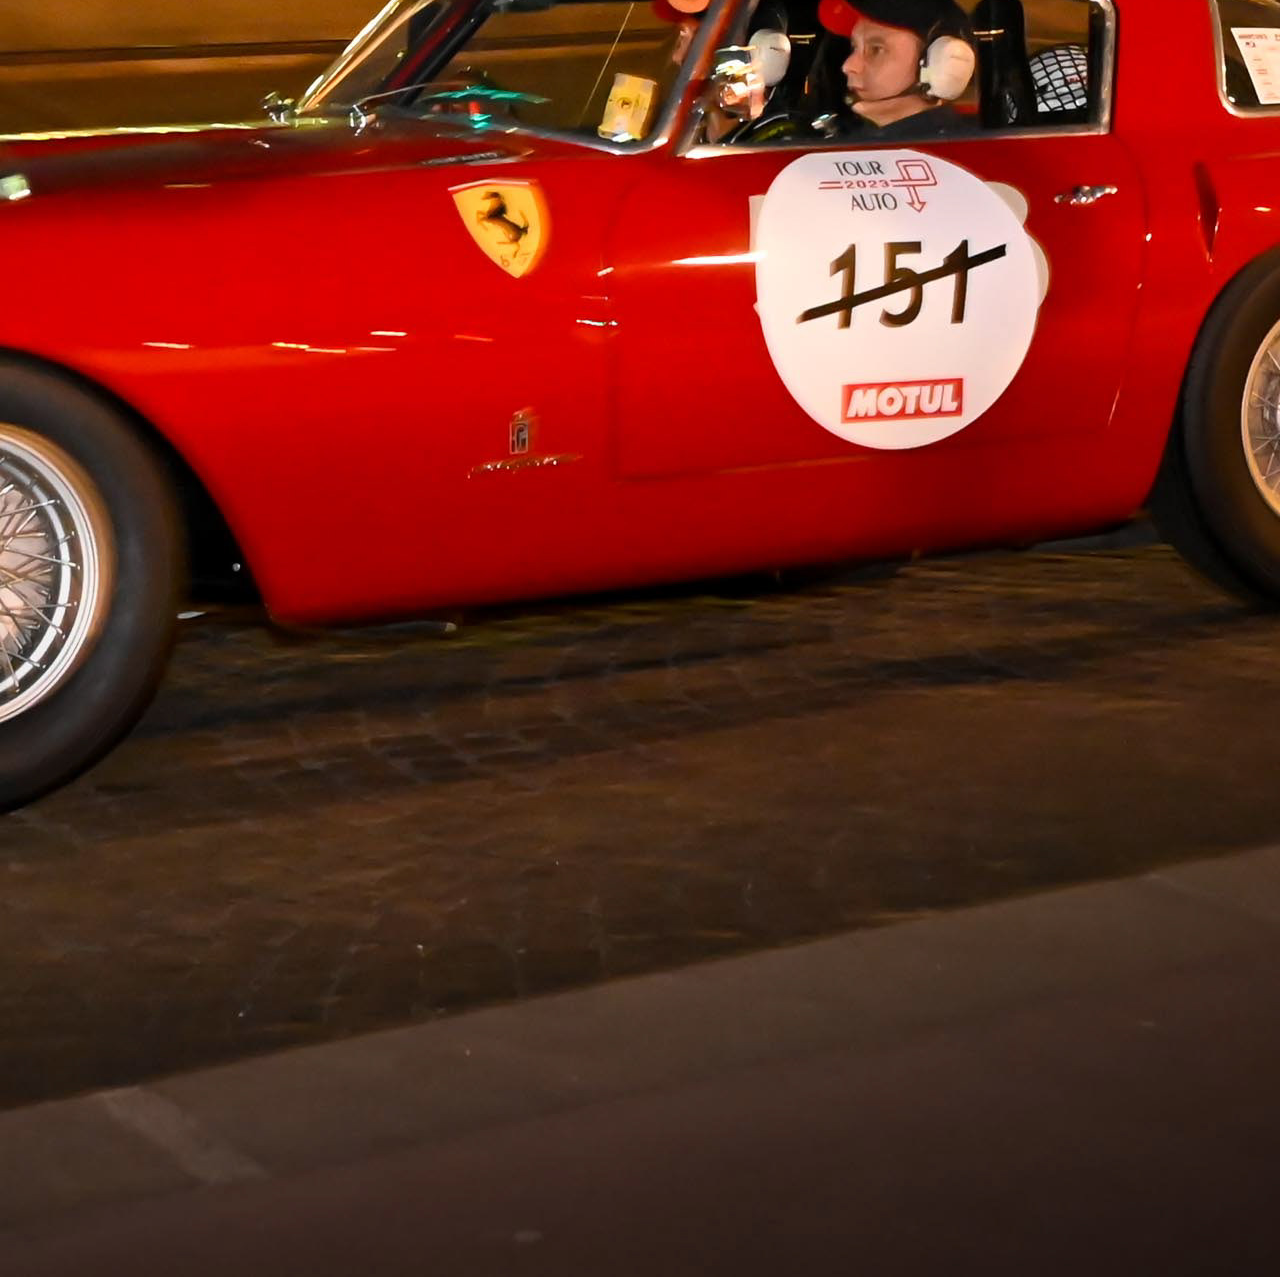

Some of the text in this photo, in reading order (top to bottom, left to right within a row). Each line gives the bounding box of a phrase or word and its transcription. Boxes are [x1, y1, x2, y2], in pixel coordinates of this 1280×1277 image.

[834, 161, 885, 176] TOUR
[845, 180, 890, 189] 2023
[851, 192, 898, 211] AUTO
[829, 239, 969, 329] 151
[847, 384, 959, 418] MOTUL
